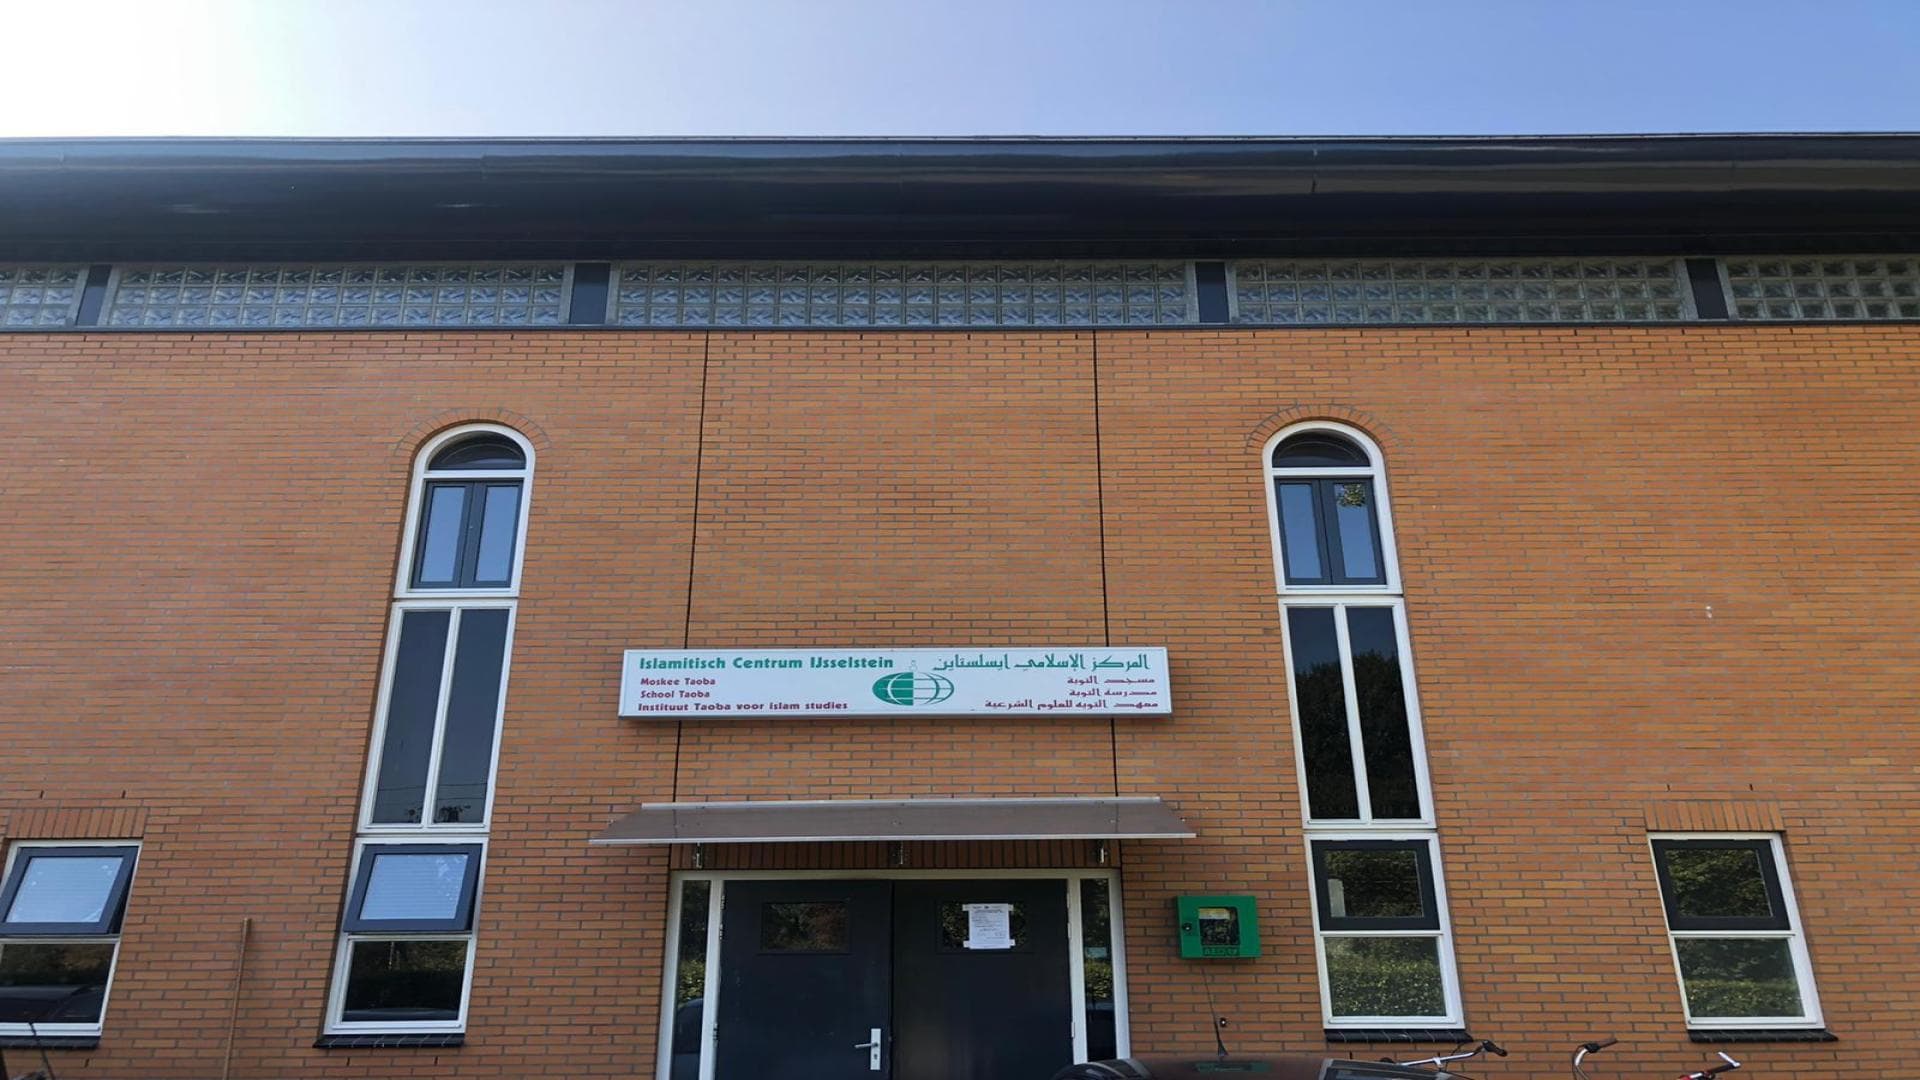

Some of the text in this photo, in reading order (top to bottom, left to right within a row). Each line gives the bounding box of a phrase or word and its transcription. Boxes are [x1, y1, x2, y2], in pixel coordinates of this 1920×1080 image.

[639, 656, 894, 670] Islamitisch Centrum IJsselstein
[1091, 653, 1151, 673] المركز
[640, 677, 716, 686] Moskee Taoba
[1103, 677, 1155, 687] مسجد
[640, 689, 710, 699] School Taoba
[637, 702, 689, 712] Instituut
[693, 702, 731, 711] Taoba
[805, 701, 848, 710] studies
[984, 698, 1034, 710] الشرعية
[1037, 699, 1073, 711] للعلوم
[1113, 701, 1159, 710] معهد
